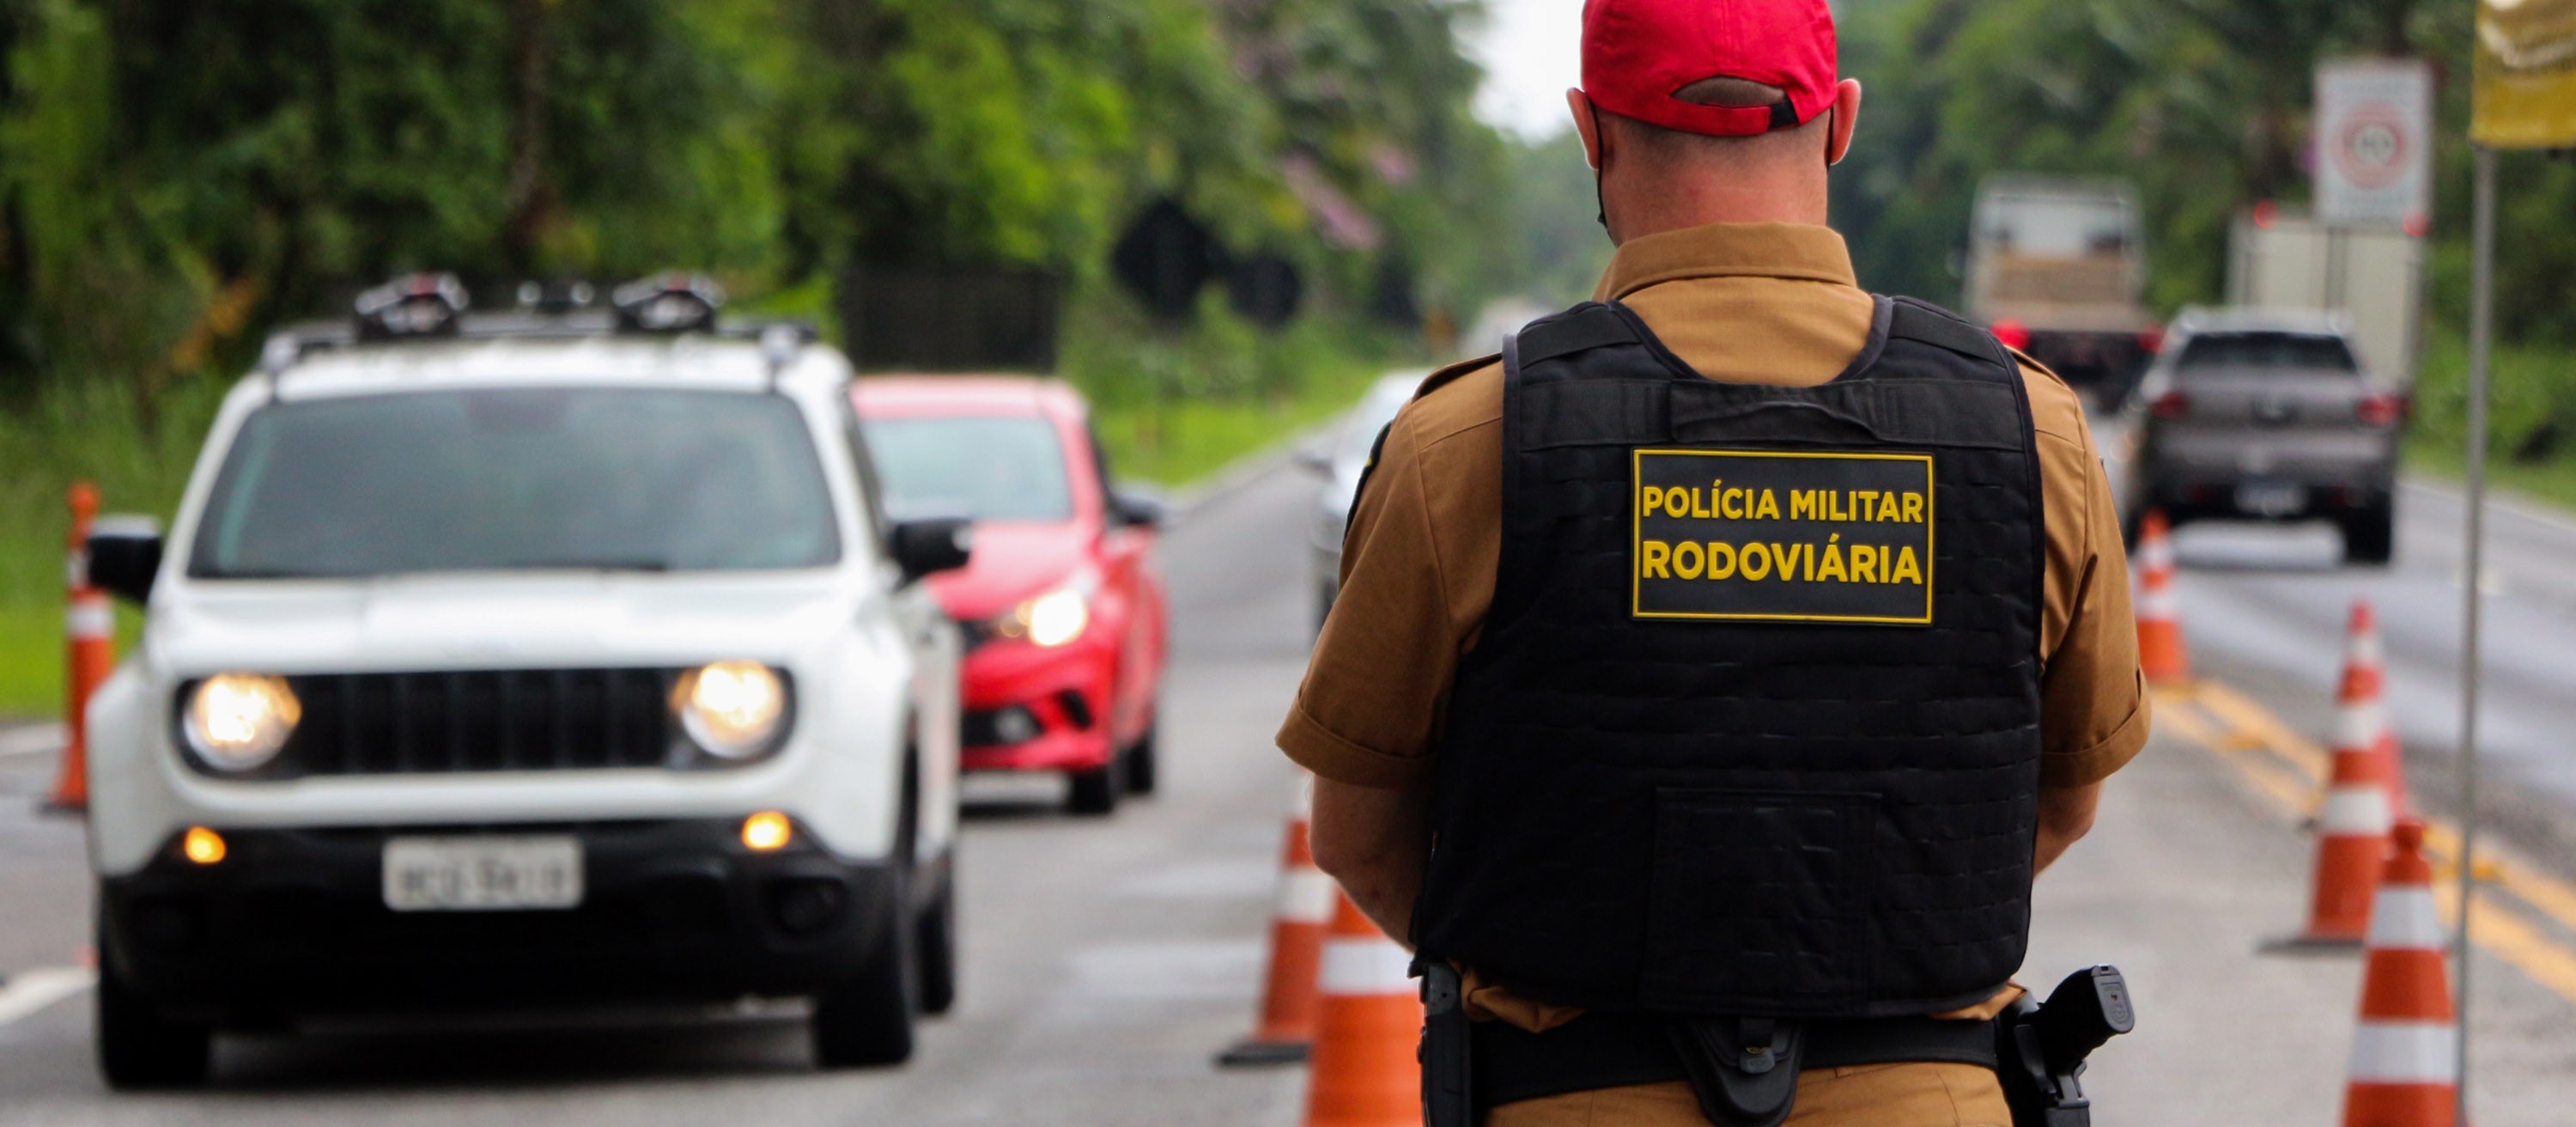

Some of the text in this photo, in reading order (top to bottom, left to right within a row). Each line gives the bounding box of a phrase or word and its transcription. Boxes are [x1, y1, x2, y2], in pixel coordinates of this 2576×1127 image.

[1643, 478, 1923, 523] POLÍCIA MILITAR
[1642, 533, 1923, 584] RODOVIÁRIA
